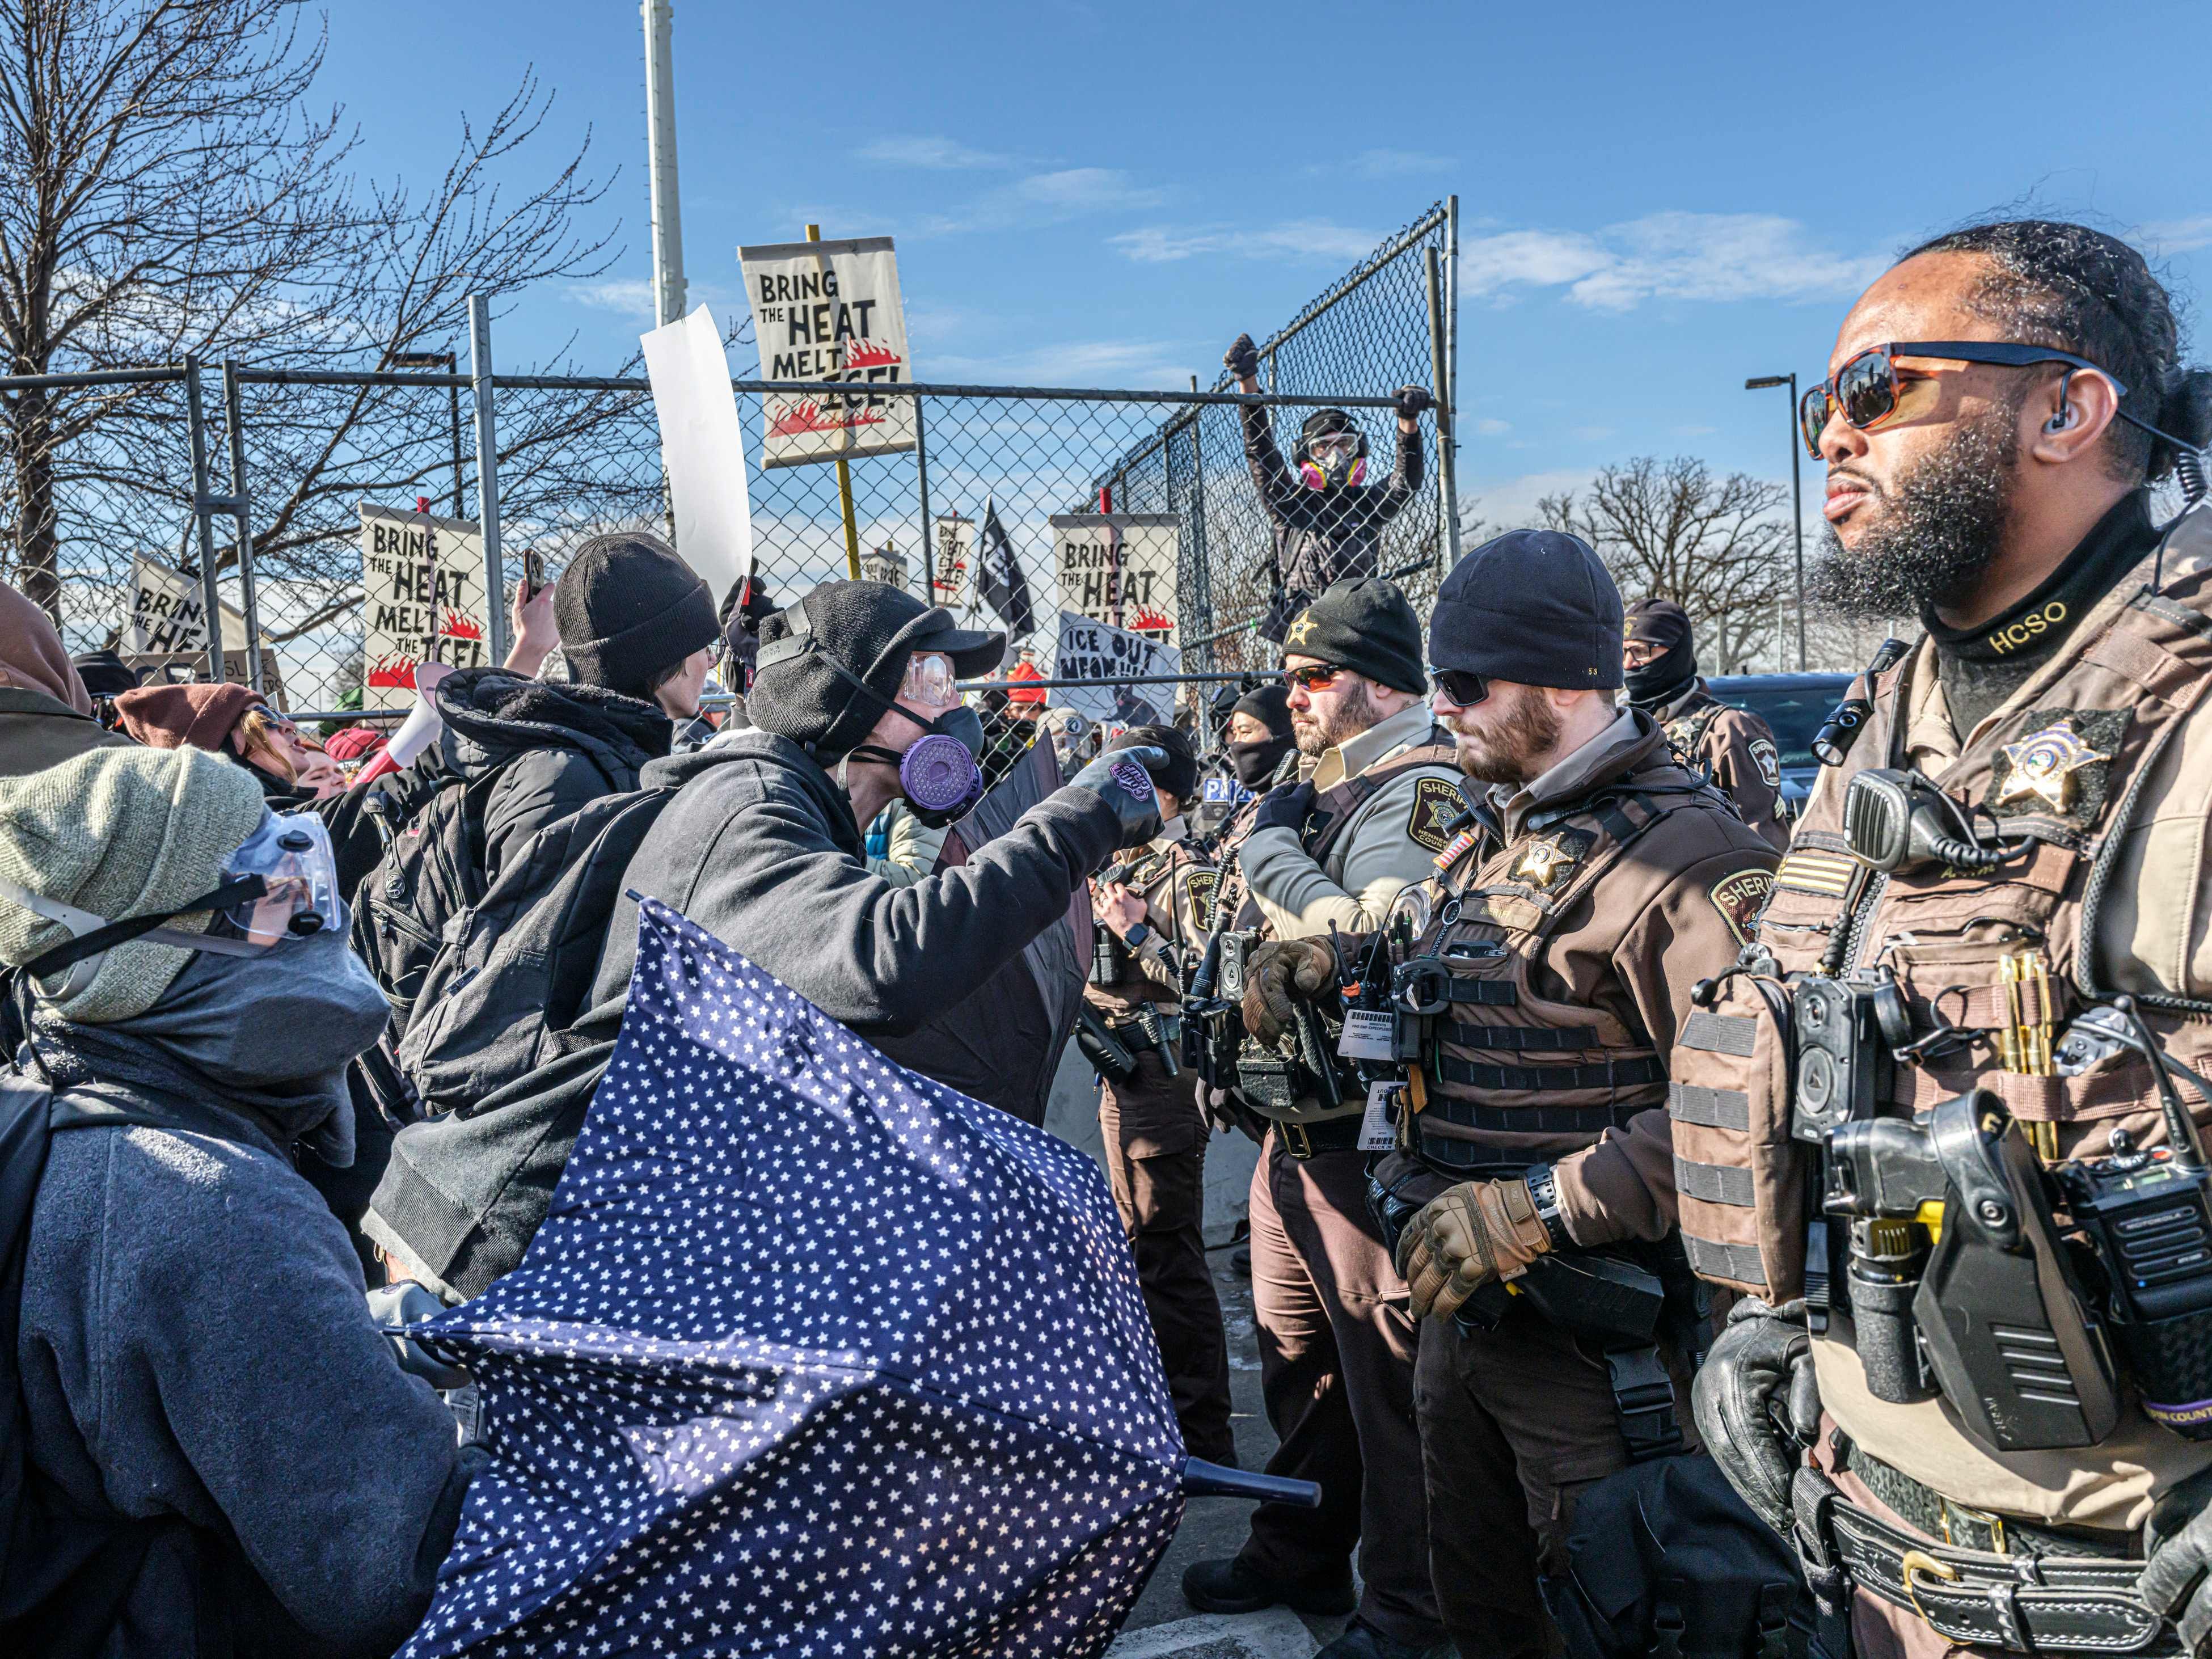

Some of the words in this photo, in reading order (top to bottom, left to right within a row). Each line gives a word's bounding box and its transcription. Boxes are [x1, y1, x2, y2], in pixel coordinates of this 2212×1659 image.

[759, 270, 839, 303] BRING
[759, 307, 784, 323] THE
[788, 299, 876, 346] HEAT
[771, 348, 842, 380] MELT
[820, 366, 900, 411] ICE!
[373, 523, 440, 562] BRING
[1065, 542, 1129, 569] BRING
[370, 557, 392, 575] THE
[394, 561, 469, 609] HEAT
[1061, 573, 1082, 586] THE
[1083, 571, 1156, 607] HEAT
[136, 588, 205, 627] BRIN
[374, 605, 437, 634] MELT
[145, 621, 208, 653] HE
[1989, 602, 2066, 654] HCSO
[397, 638, 418, 653] THE
[1069, 630, 1100, 652] ICE
[1112, 634, 1158, 669] OUT
[1422, 783, 1468, 809] SHERIF
[1418, 829, 1447, 846] HENNEP
[1191, 876, 1215, 888] SHER
[1720, 877, 1771, 906] SHERI
[2170, 1406, 2212, 1422] COUNT
